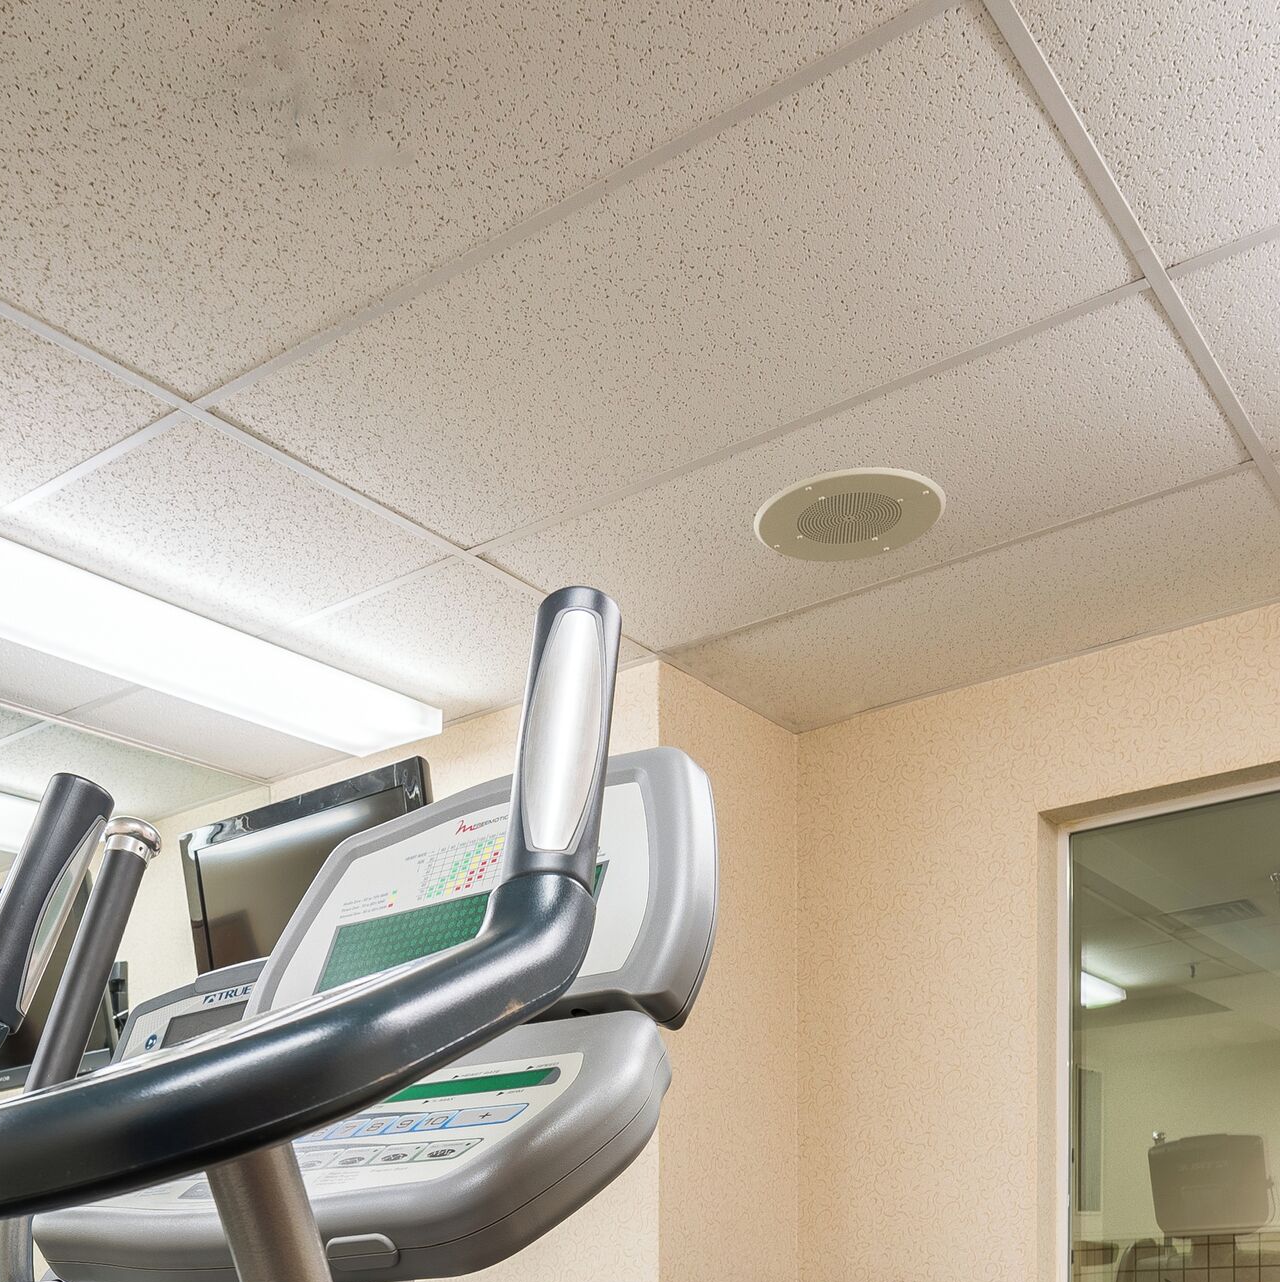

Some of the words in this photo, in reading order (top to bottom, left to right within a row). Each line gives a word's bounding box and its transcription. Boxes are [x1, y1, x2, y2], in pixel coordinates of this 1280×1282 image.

[218, 984, 252, 1001] TRUE
[396, 1119, 414, 1129] 9
[424, 1116, 449, 1127] 10
